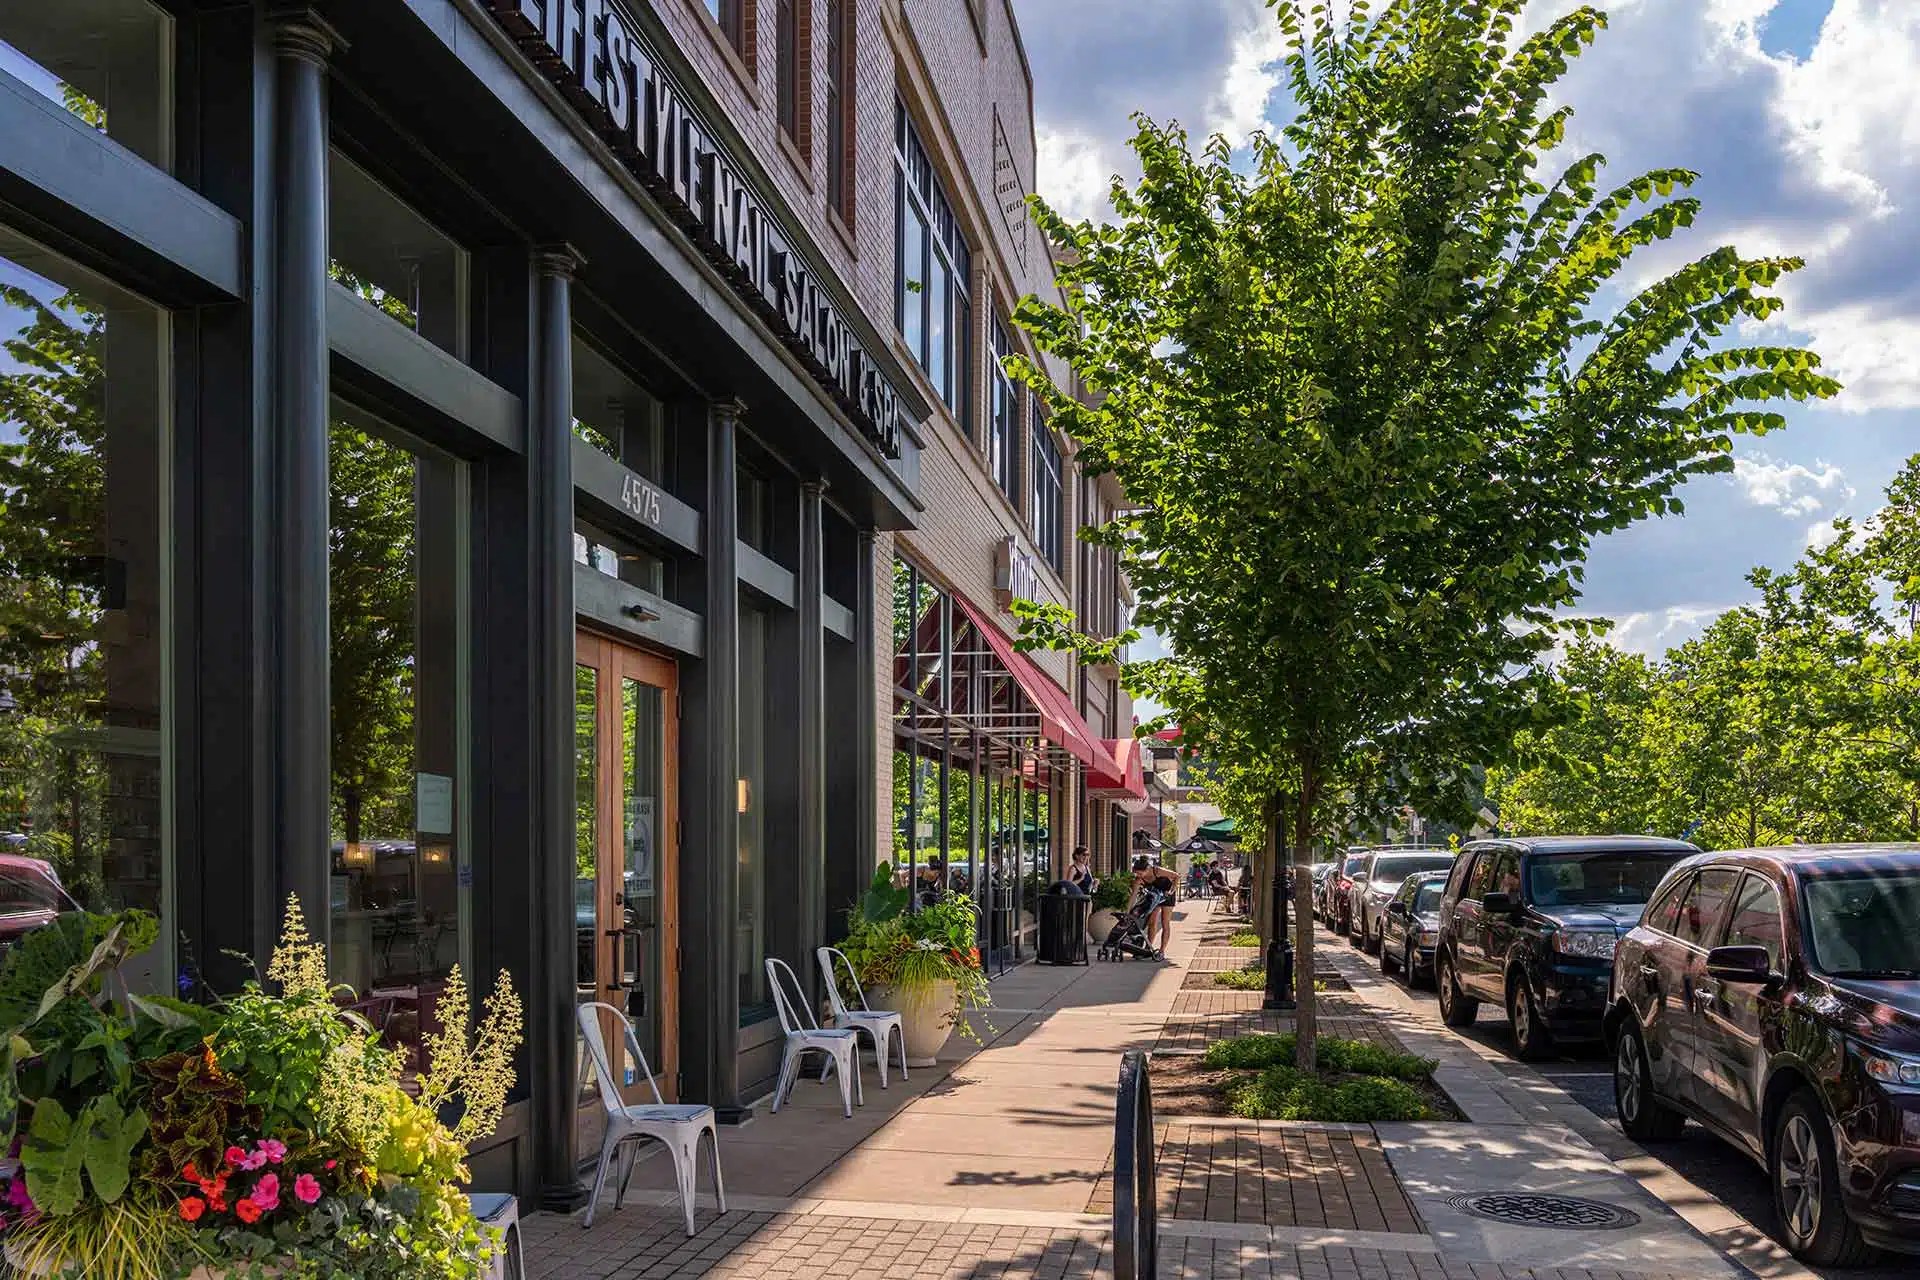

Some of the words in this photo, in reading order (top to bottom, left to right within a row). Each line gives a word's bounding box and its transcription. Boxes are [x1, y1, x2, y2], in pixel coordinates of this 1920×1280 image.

[520, 0, 703, 223] FESTYLE
[714, 156, 776, 311] NAIL
[784, 250, 849, 400] SALON
[858, 349, 870, 417] &
[874, 370, 900, 458] SPA
[621, 473, 660, 524] 4575
